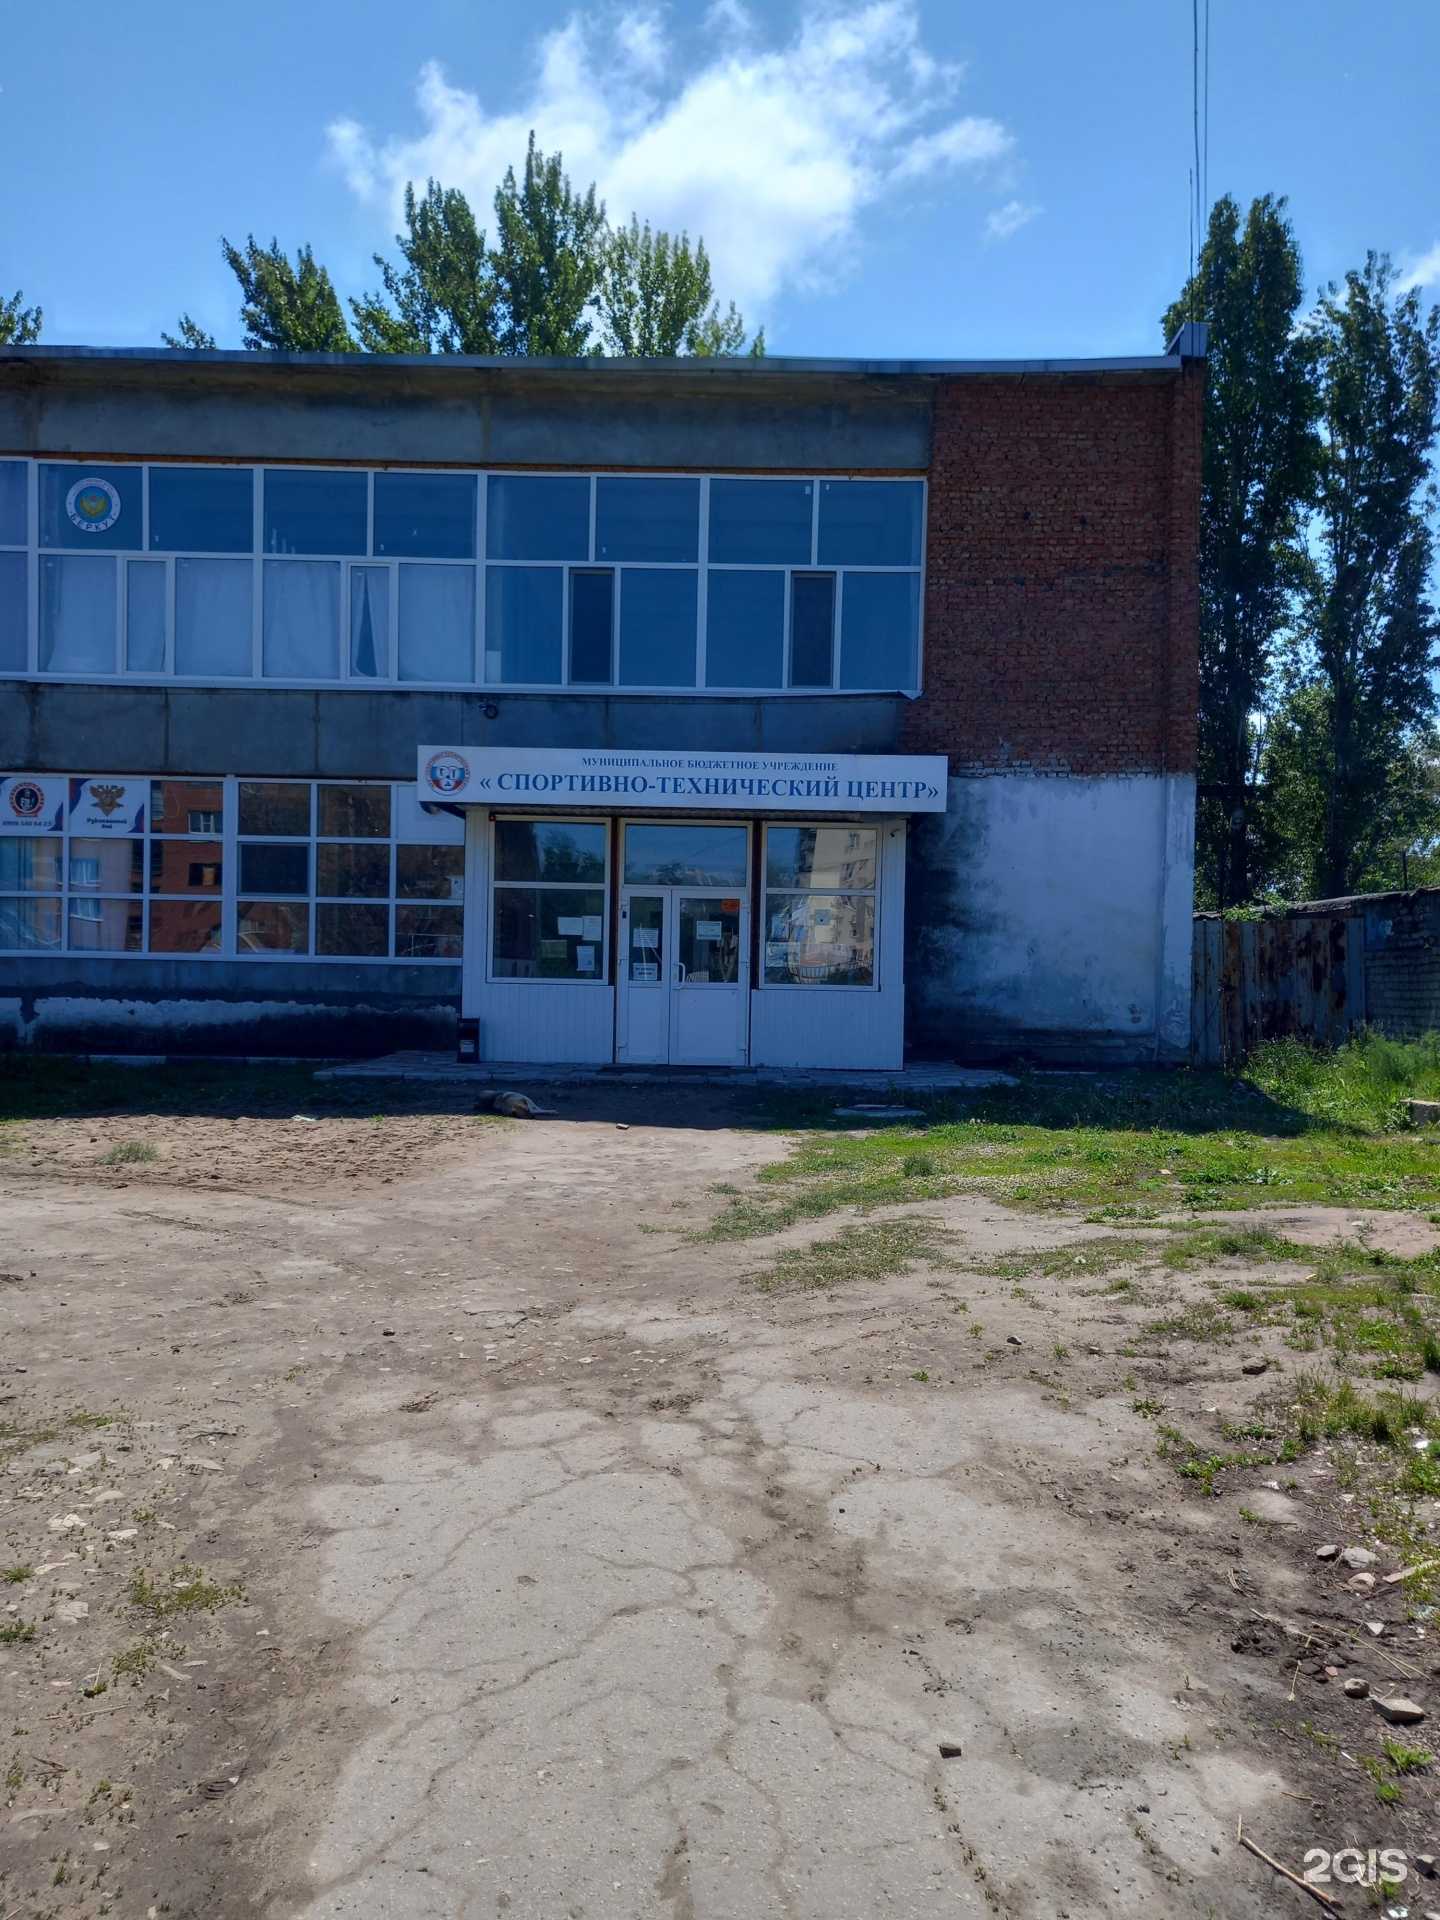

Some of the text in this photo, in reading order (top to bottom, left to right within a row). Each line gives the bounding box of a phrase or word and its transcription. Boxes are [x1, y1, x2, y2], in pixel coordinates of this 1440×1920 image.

[582, 757, 838, 772] МУНИЦИПАЛЬНОЕ БЮДЖЕТНОЕ УЧРЕЖДЕНИЕ
[497, 773, 840, 798] СПОРТИВНО-ТЕХНИЧЕСКИЙ
[847, 780, 939, 801] ЦЕНТР»
